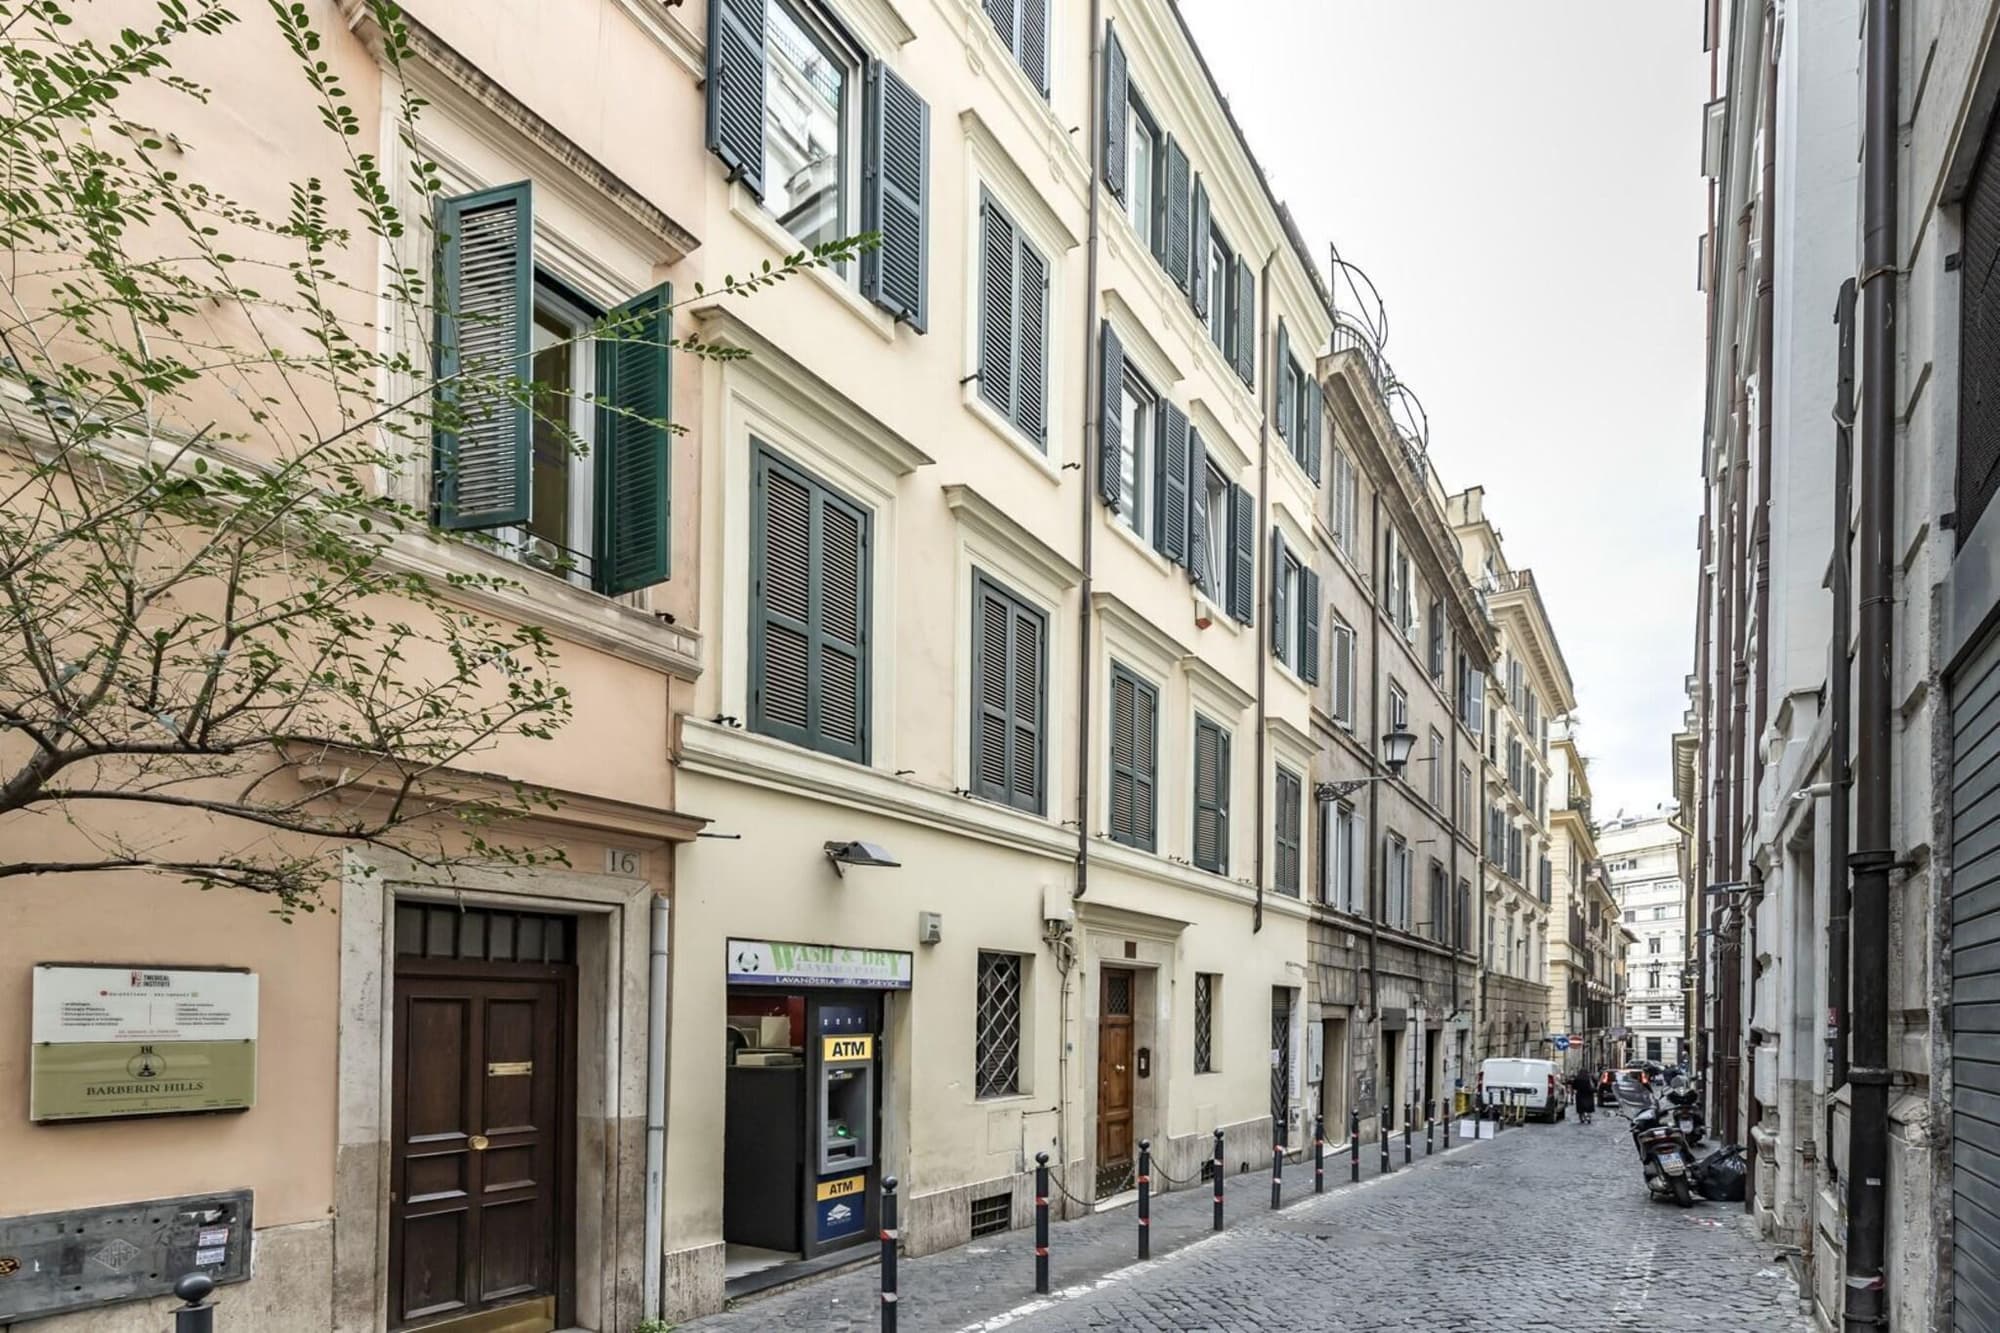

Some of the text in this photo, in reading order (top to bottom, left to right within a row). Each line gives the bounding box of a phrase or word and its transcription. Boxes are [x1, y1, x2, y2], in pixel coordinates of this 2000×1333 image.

[611, 851, 637, 873] 16
[769, 943, 834, 972] WASH
[862, 951, 902, 977] DRY
[775, 975, 836, 986] LAVANDERIA
[866, 979, 900, 988] SERVICE
[832, 1041, 865, 1057] ATM
[86, 1081, 204, 1097] BARBERIN HILLS
[829, 1180, 853, 1195] ATM
